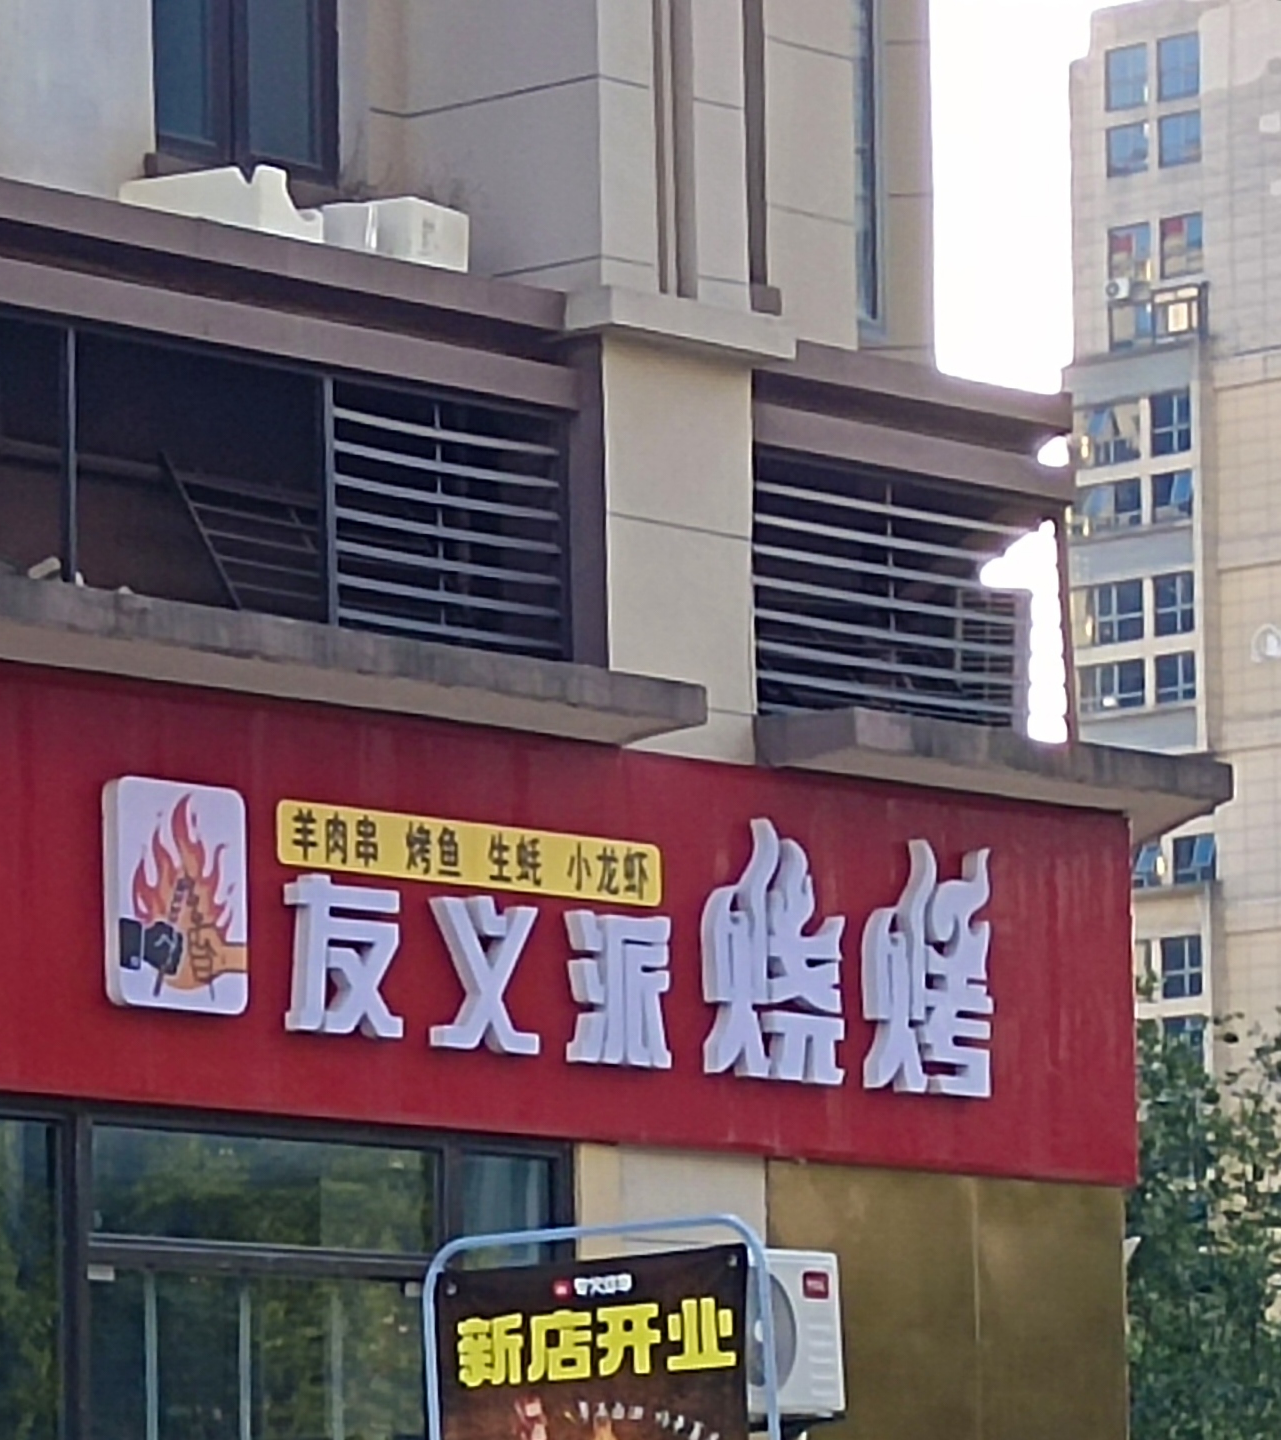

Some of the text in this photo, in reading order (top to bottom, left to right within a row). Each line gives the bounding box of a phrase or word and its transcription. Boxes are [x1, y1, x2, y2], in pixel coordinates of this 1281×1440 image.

[291, 808, 650, 901] 羊肉串 烤鱼 生蚝 小龙虾
[282, 816, 994, 1098] 友义派烧烤
[456, 1297, 738, 1387] 新店开业
